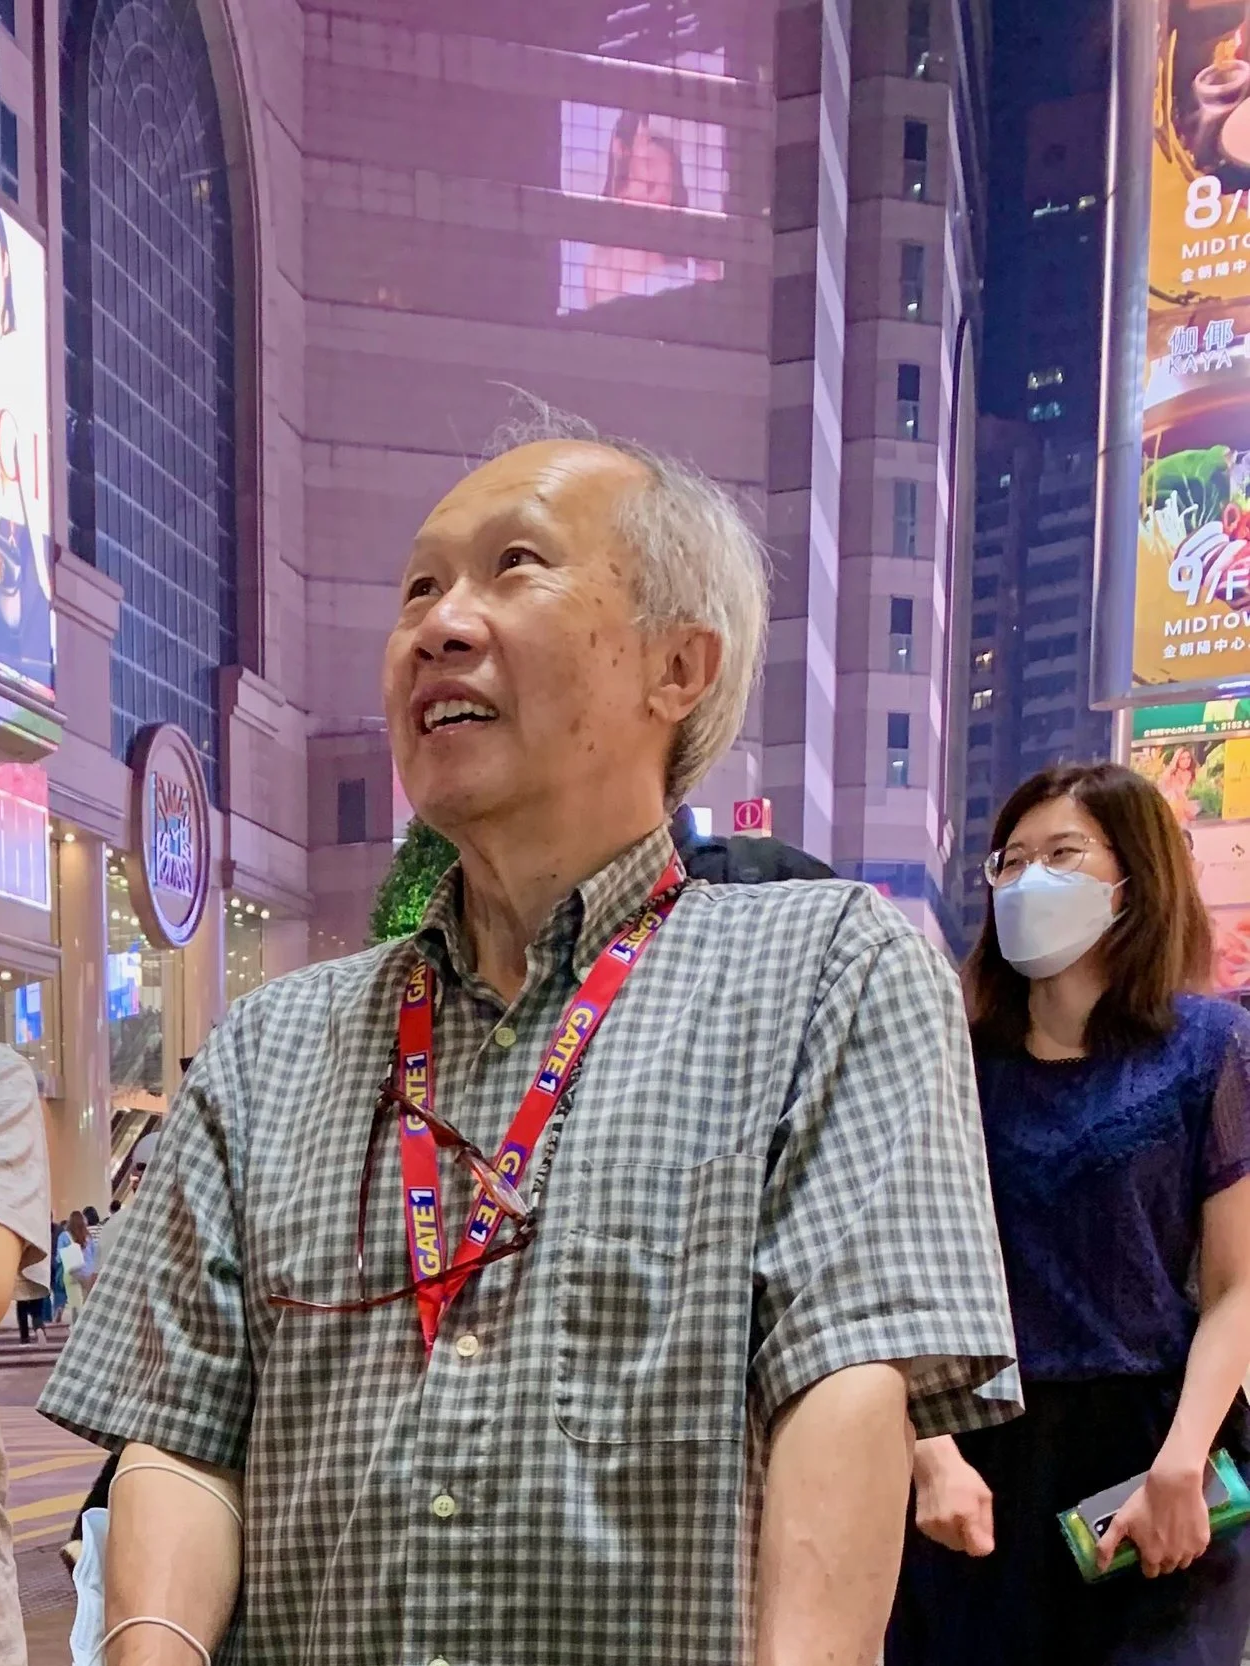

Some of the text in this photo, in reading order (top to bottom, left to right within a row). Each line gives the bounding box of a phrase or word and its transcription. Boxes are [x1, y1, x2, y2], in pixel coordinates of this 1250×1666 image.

[1184, 175, 1250, 229] 8/
[1167, 348, 1233, 375] KAYA
[1162, 636, 1250, 659] 金朝陽中心
[470, 1150, 521, 1243] GE1
